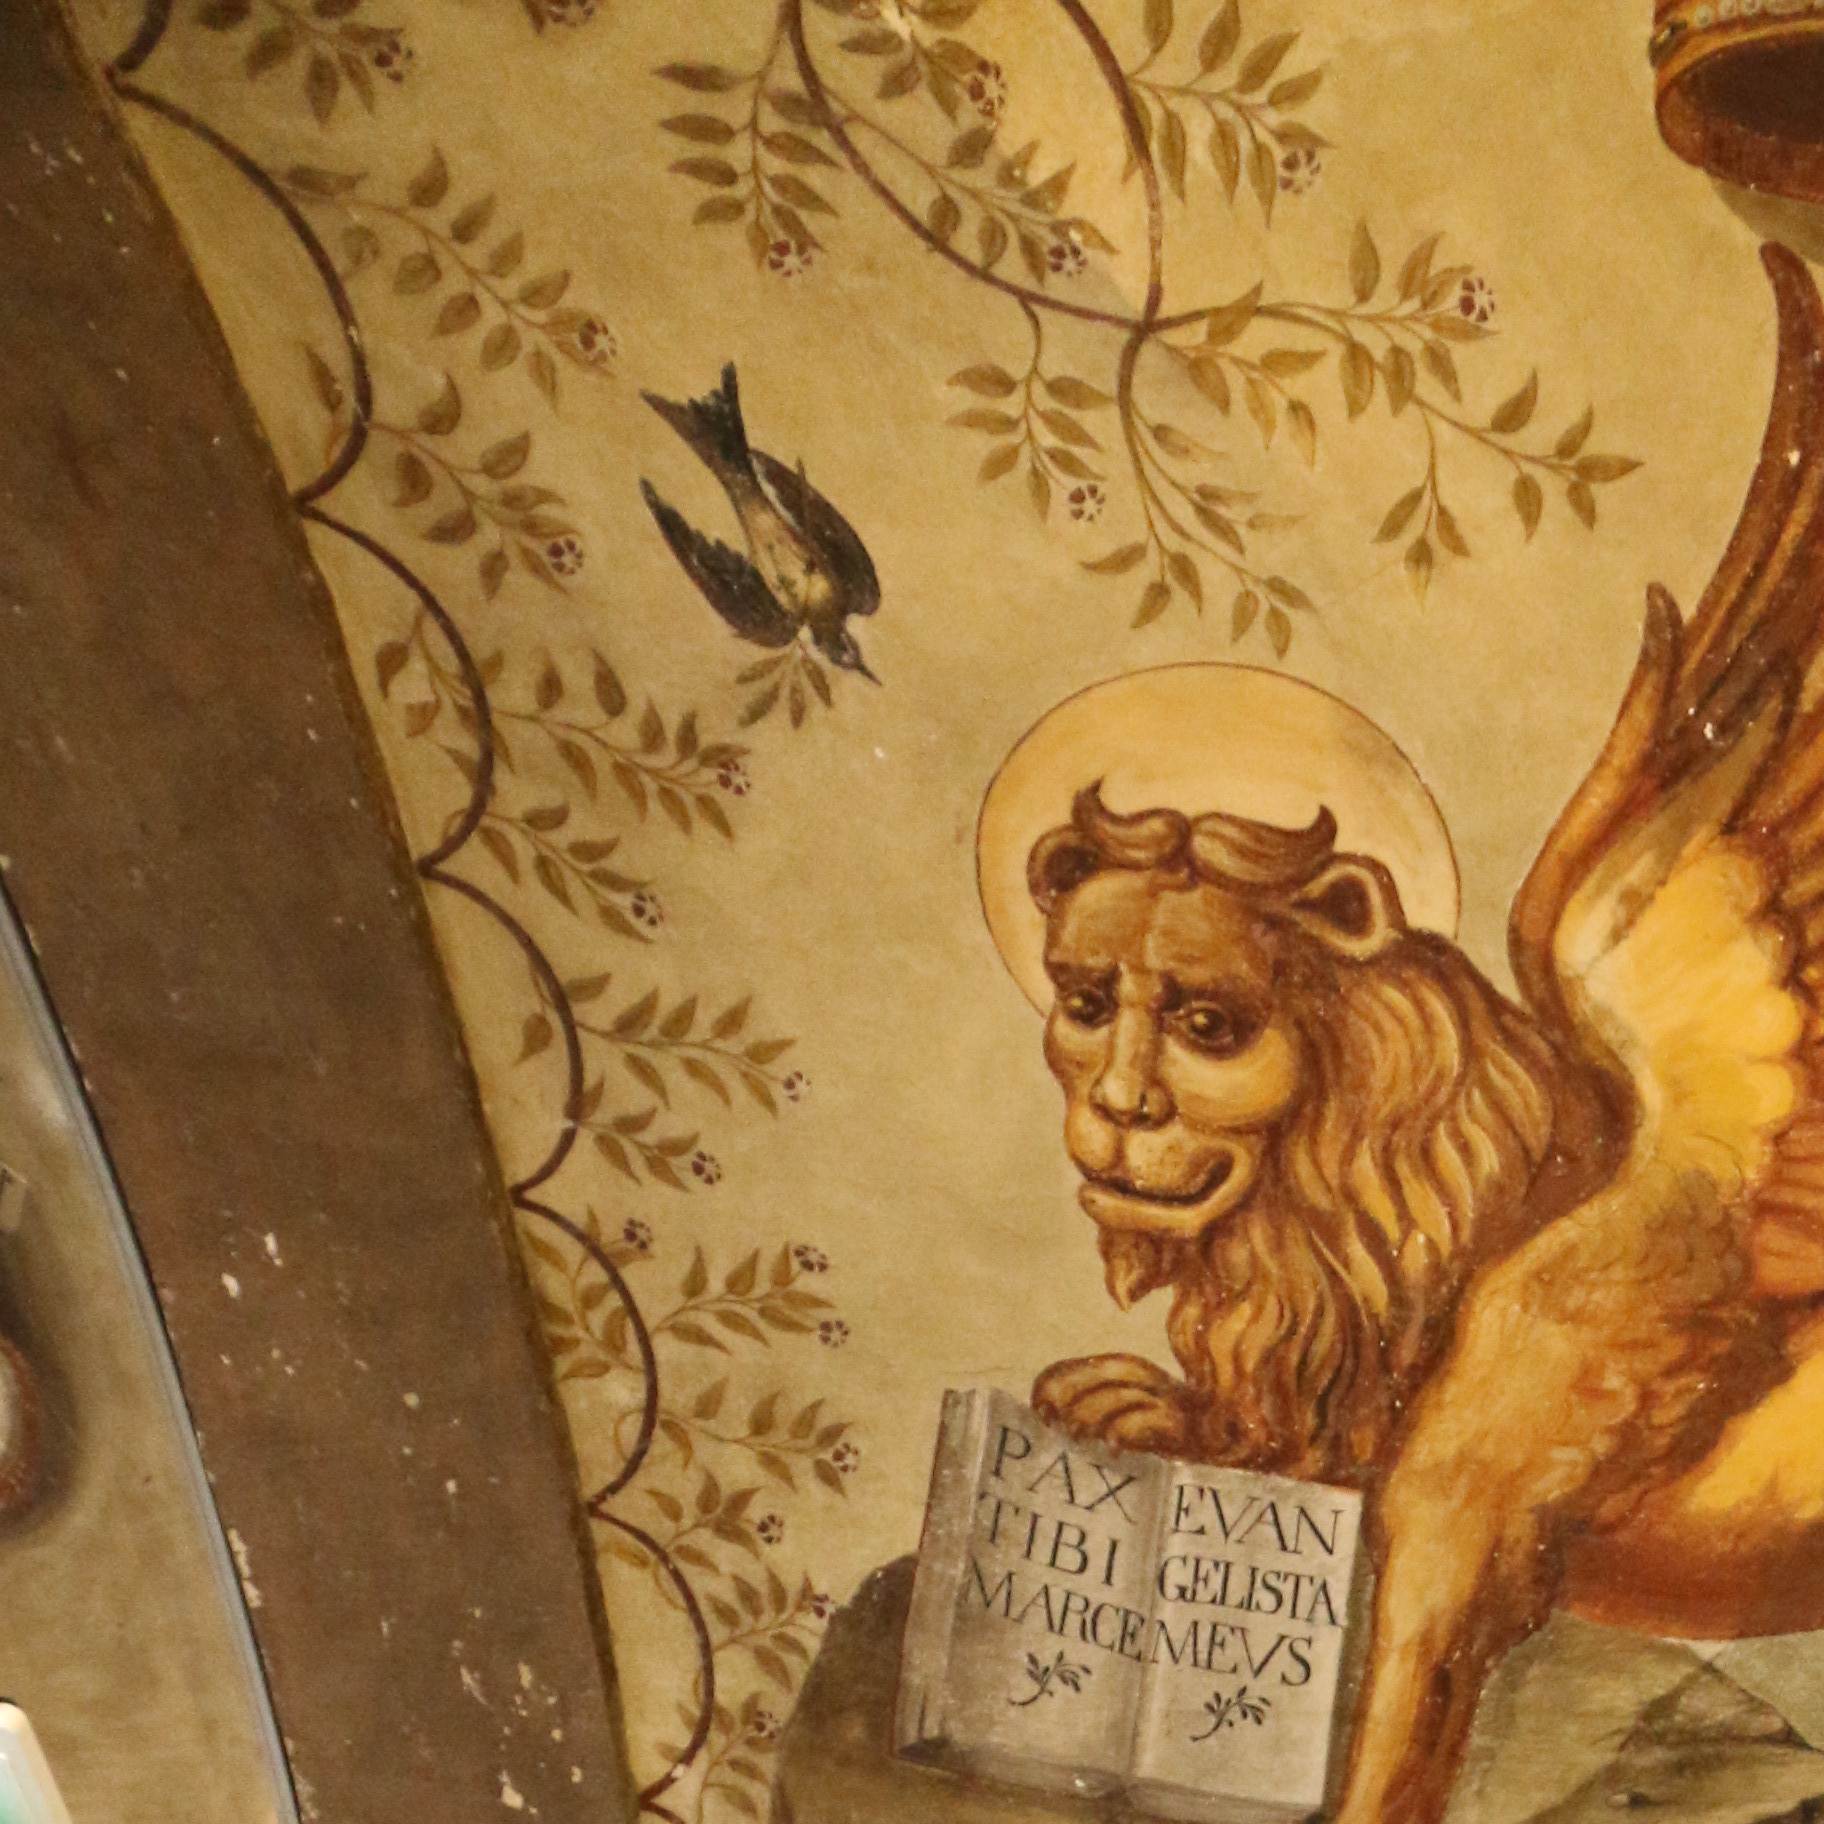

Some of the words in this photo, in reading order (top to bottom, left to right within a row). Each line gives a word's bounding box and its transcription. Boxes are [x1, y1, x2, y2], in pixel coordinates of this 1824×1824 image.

[994, 1427, 1137, 1523] PAX
[968, 1490, 1118, 1587] TIBI
[1173, 1483, 1343, 1556] EVAN
[964, 1556, 1148, 1663] MARCE
[1158, 1554, 1343, 1630] GELISTA
[1152, 1618, 1313, 1687] MEVS
